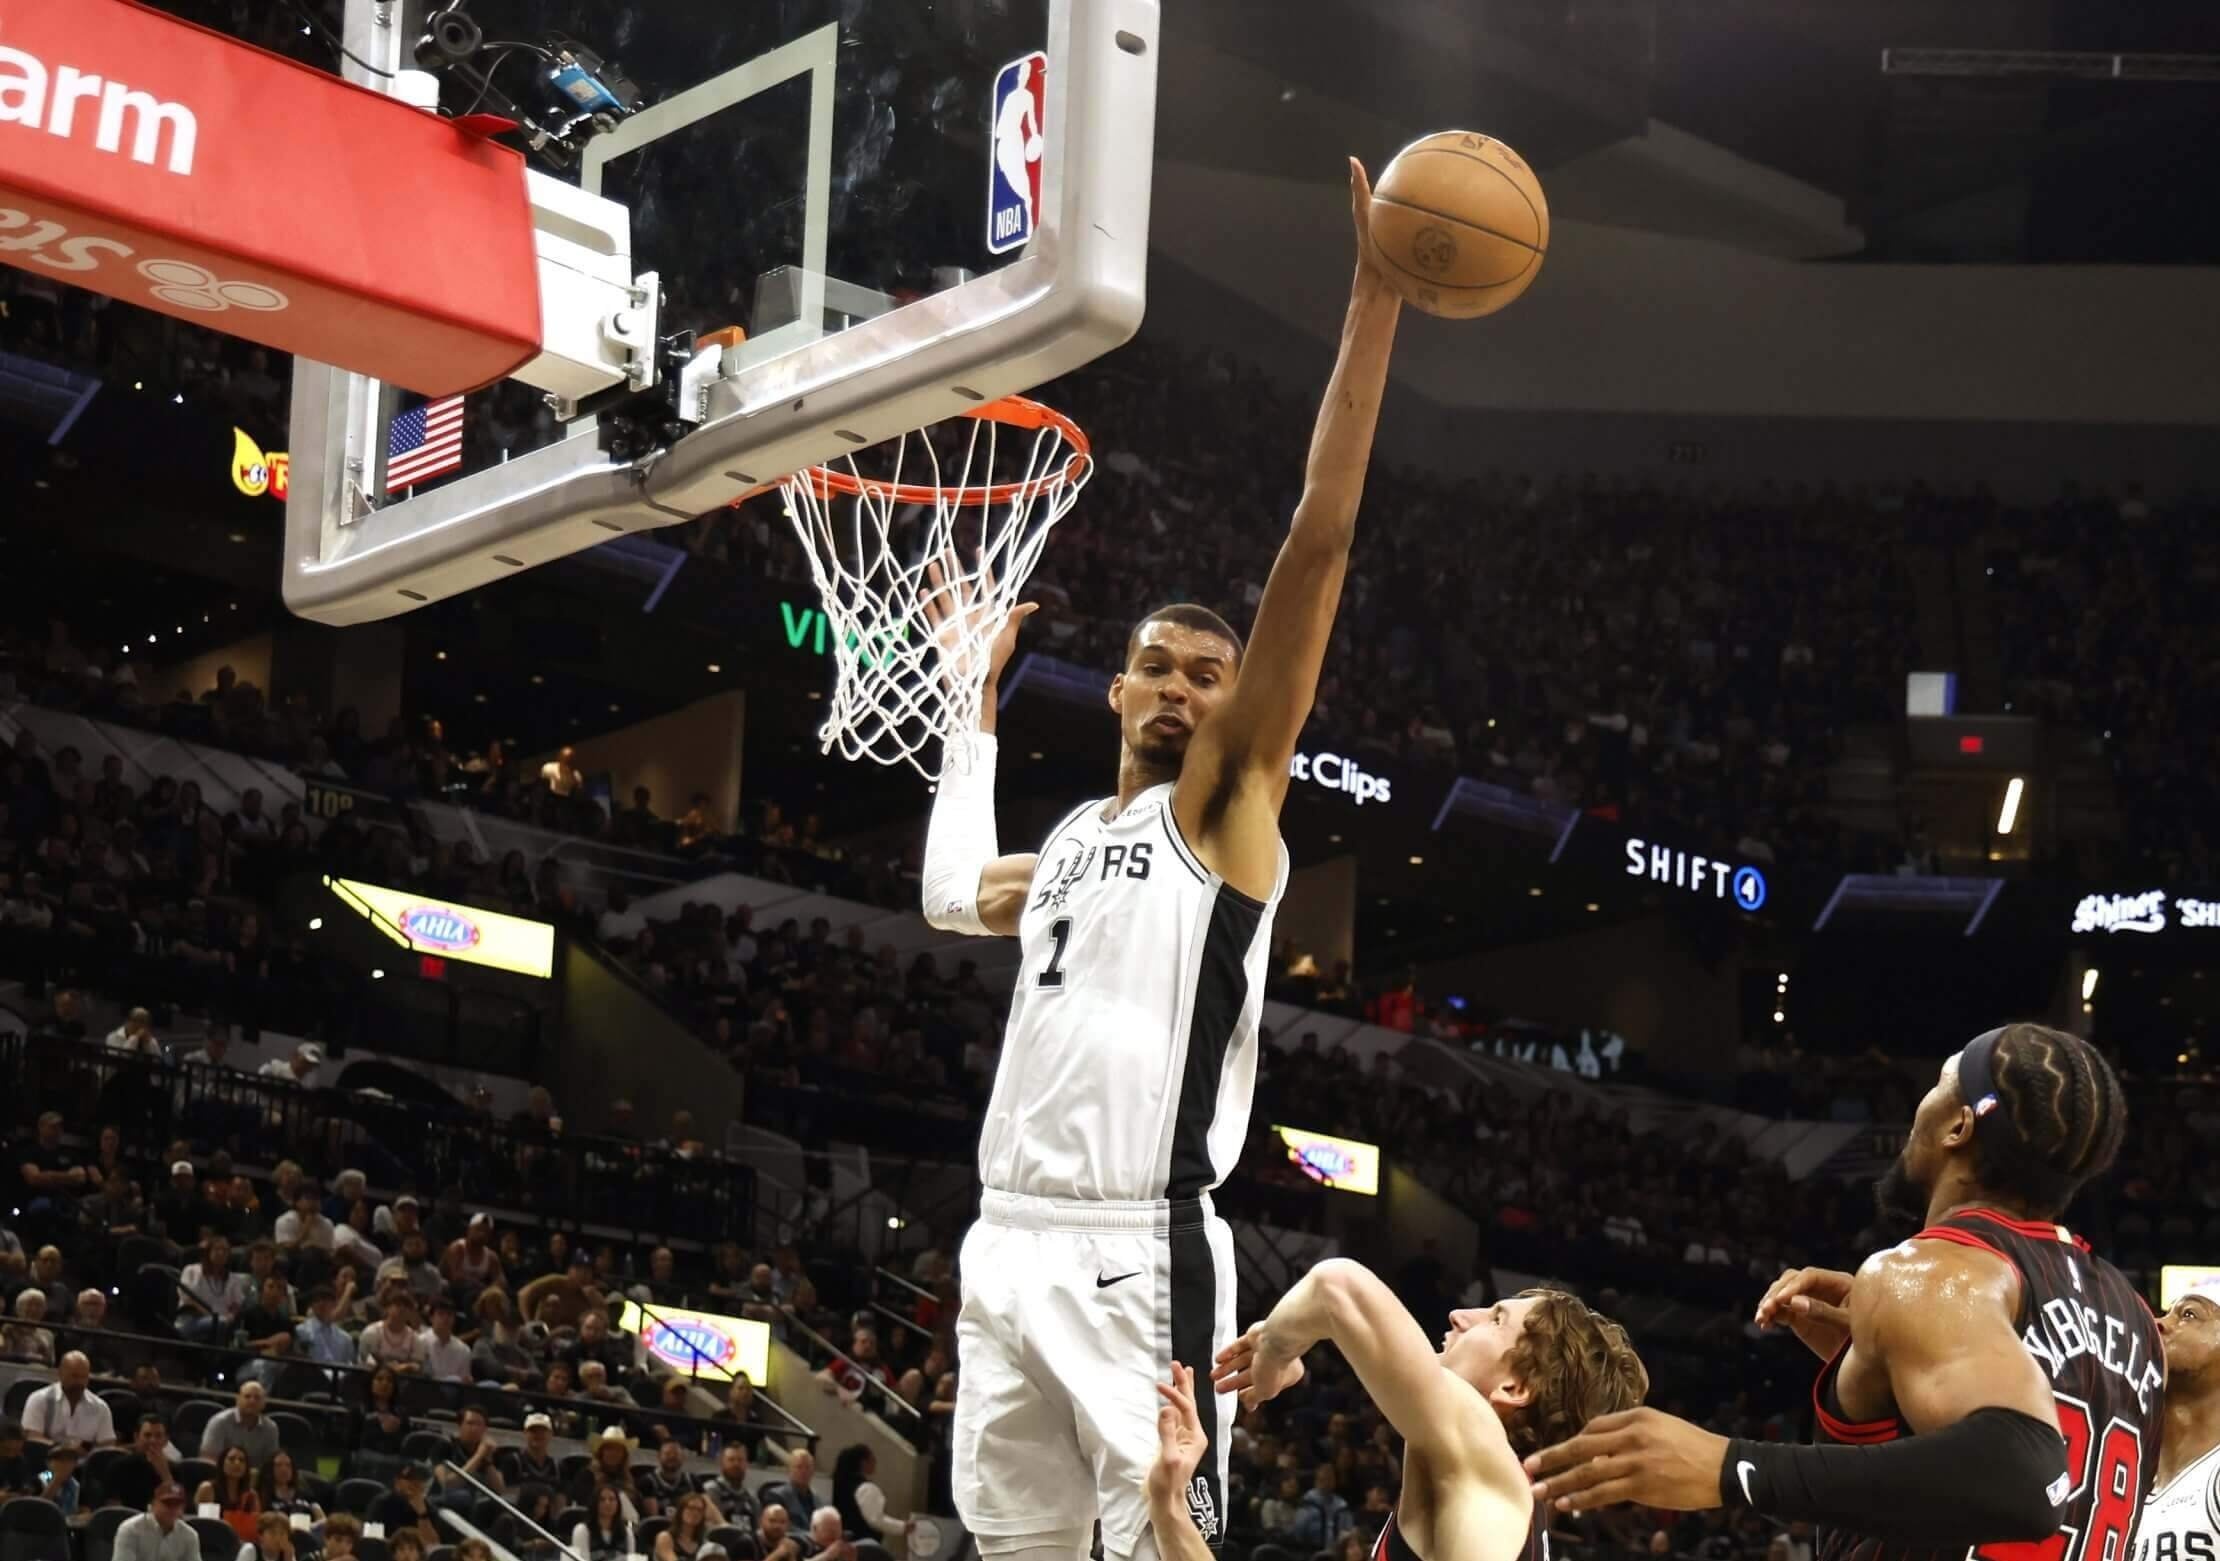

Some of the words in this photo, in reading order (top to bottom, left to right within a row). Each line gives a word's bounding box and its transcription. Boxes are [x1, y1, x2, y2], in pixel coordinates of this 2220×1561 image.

[0, 44, 198, 176] arm
[996, 204, 1021, 240] NBA
[1312, 752, 1391, 805] Clips
[1036, 916, 1073, 988] 1
